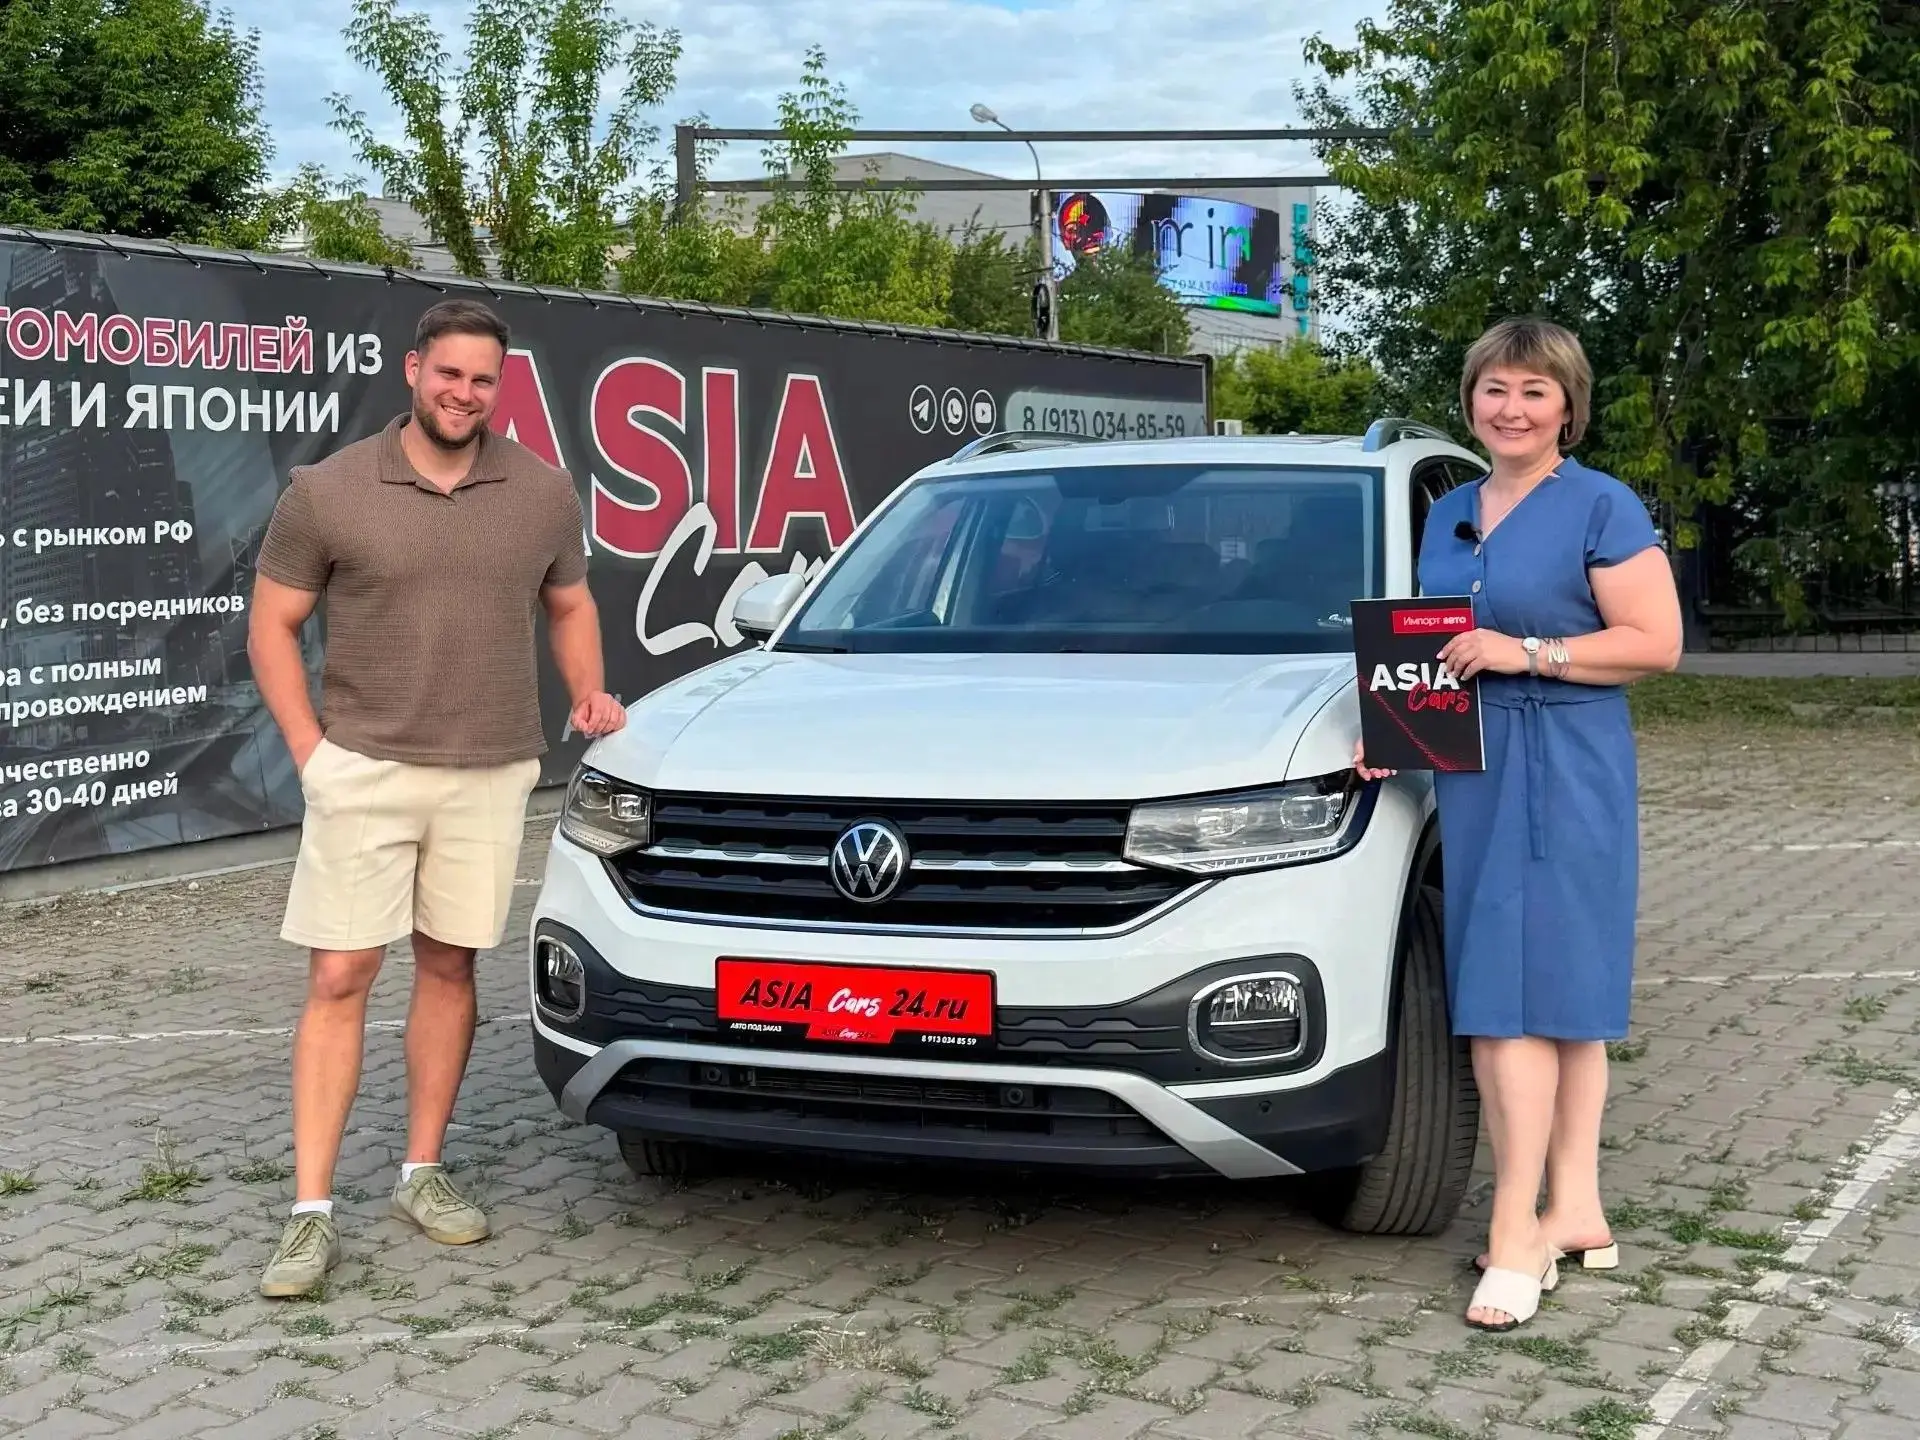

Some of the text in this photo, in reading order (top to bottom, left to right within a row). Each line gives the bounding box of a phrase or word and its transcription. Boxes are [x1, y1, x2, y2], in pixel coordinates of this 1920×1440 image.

[0, 306, 383, 375] ОМОБИЛЕЙ ИЗ
[71, 381, 106, 428] И
[123, 384, 339, 433] ЯПОНИИ
[1023, 405, 1185, 440] 8 (913) 034-85-59
[13, 520, 193, 553] с рынком РФ
[15, 595, 244, 626] без посредников
[1403, 616, 1467, 627] Импорт авто
[29, 665, 44, 685] с
[51, 657, 161, 684] полным
[1370, 662, 1460, 691] ASIA
[1408, 681, 1471, 713] Cars
[26, 781, 106, 815] 30-40
[112, 772, 178, 806] дней
[739, 978, 970, 1020] ASIA Cars 24.ru
[730, 1022, 782, 1033] АВТО ПОД ЗАКАЗ
[921, 1035, 977, 1046] 8 913 034 85 59
